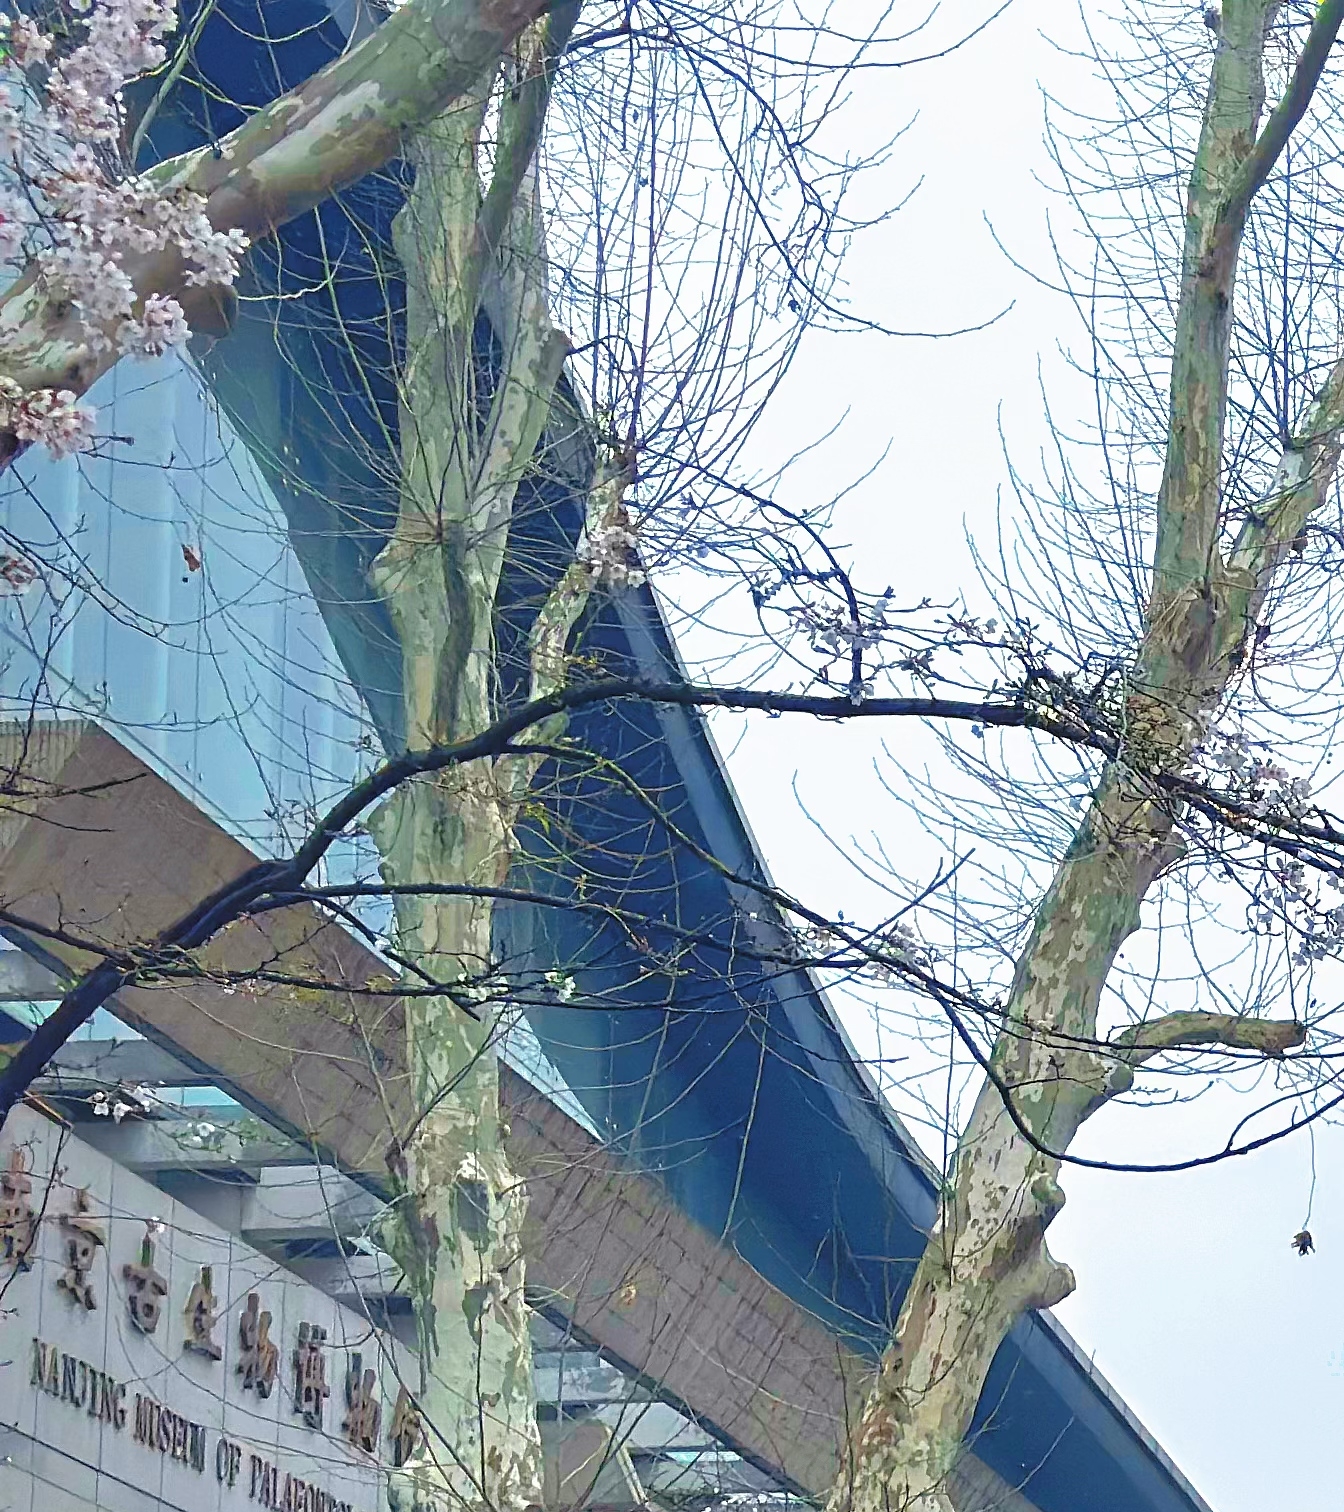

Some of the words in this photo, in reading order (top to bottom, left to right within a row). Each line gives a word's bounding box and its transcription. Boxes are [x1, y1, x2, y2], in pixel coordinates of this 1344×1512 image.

[30, 1337, 127, 1431] NANJING
[133, 1393, 206, 1473] MUSEUM
[216, 1437, 242, 1488] OF
